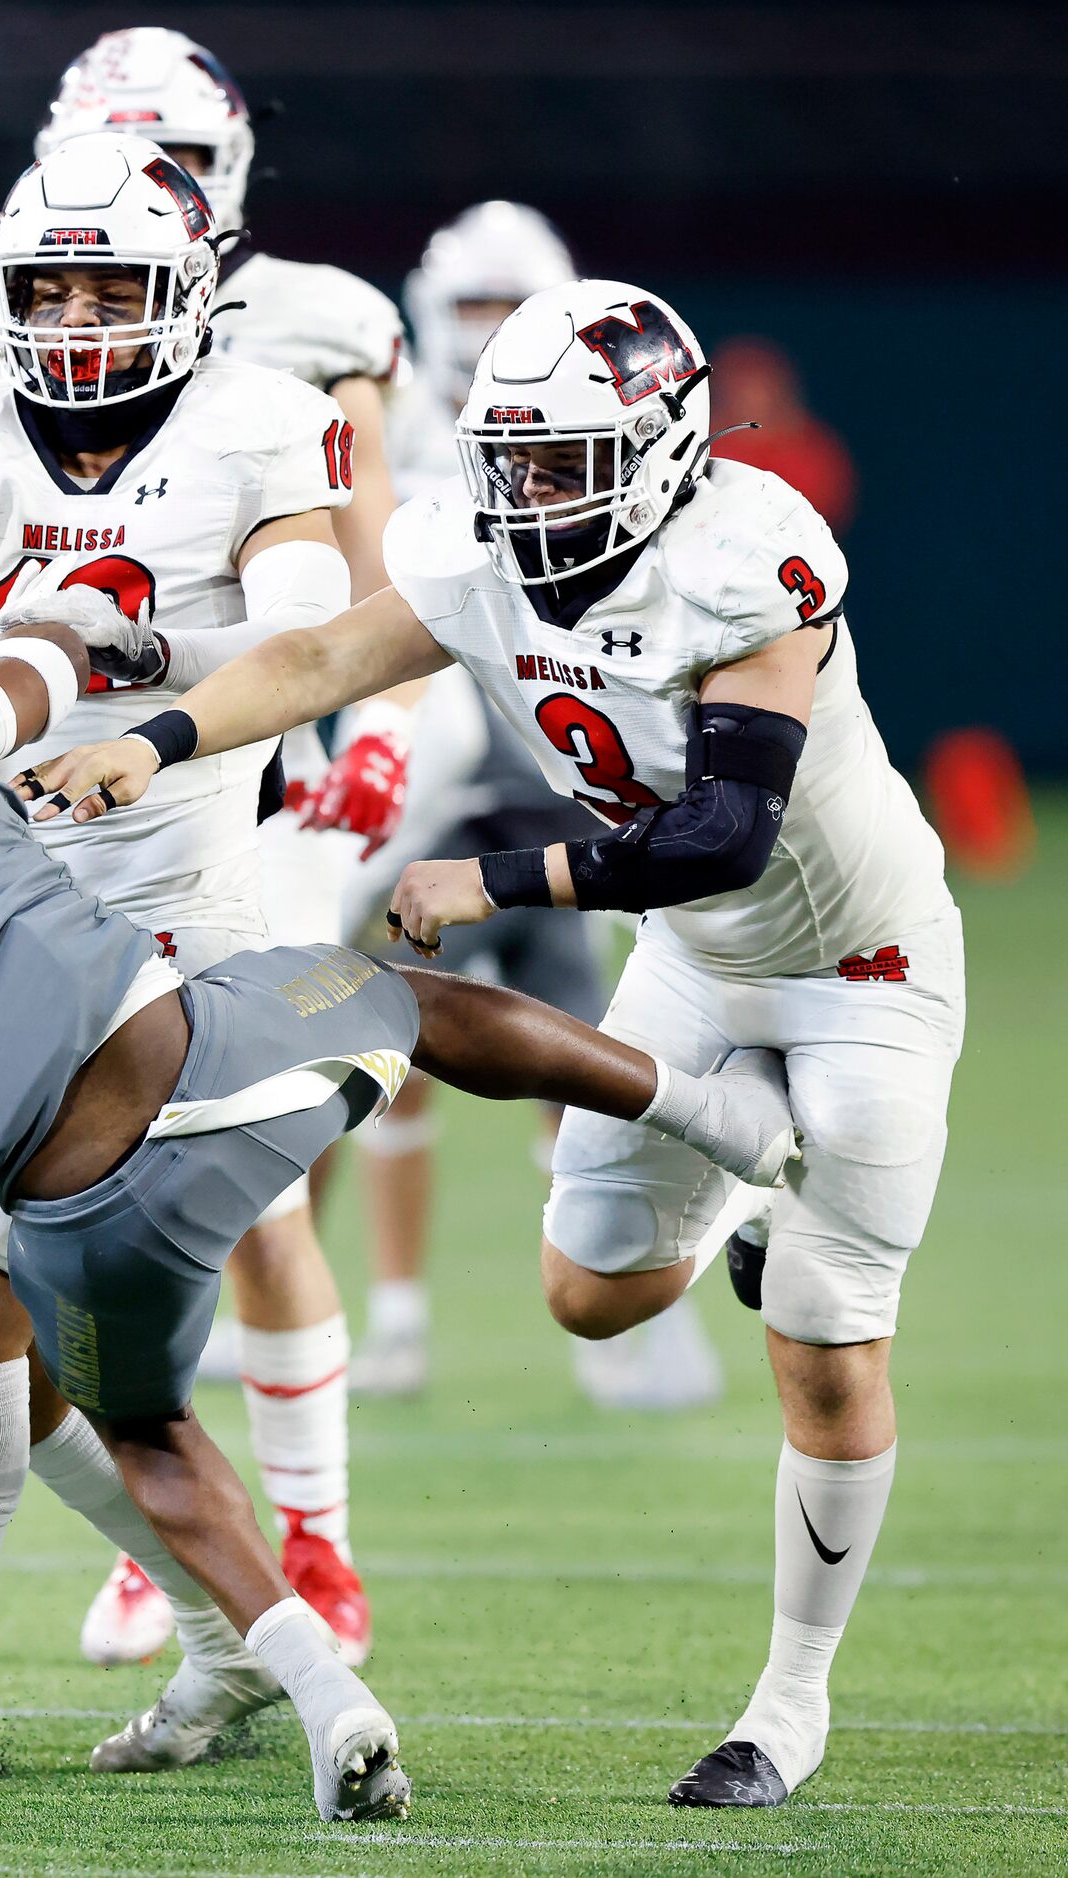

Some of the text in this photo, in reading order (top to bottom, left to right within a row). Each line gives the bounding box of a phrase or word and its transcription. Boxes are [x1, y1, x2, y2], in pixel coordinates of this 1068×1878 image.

[321, 419, 355, 490] 18
[23, 524, 125, 551] MELISSA
[778, 555, 826, 623] 3
[516, 655, 607, 691] MELISSA
[535, 692, 672, 829] 3
[844, 960, 903, 975] CARDINALS
